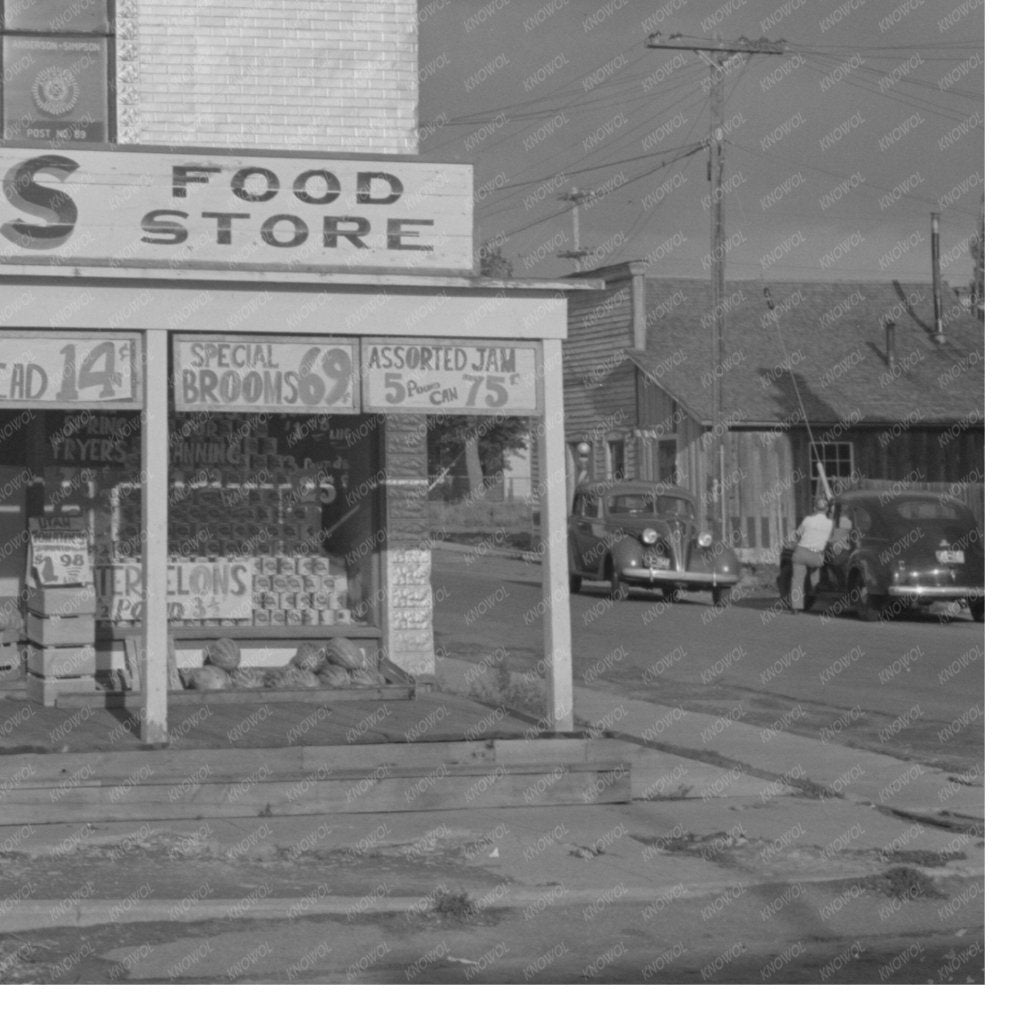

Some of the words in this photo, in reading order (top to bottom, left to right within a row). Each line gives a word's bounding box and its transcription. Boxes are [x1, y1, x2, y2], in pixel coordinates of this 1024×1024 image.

[26, 128, 50, 138] POST
[172, 165, 404, 205] FOOD
[140, 209, 434, 252] STORE
[56, 341, 130, 401] 14¢
[190, 342, 279, 369] SPECIAL
[368, 346, 468, 371] ASSORTED
[471, 347, 516, 373] JAM
[182, 369, 299, 404] BROOMS
[384, 372, 406, 404] 5
[429, 386, 458, 405] CAN
[462, 373, 520, 407] 75¢
[52, 437, 128, 463] FRYERS
